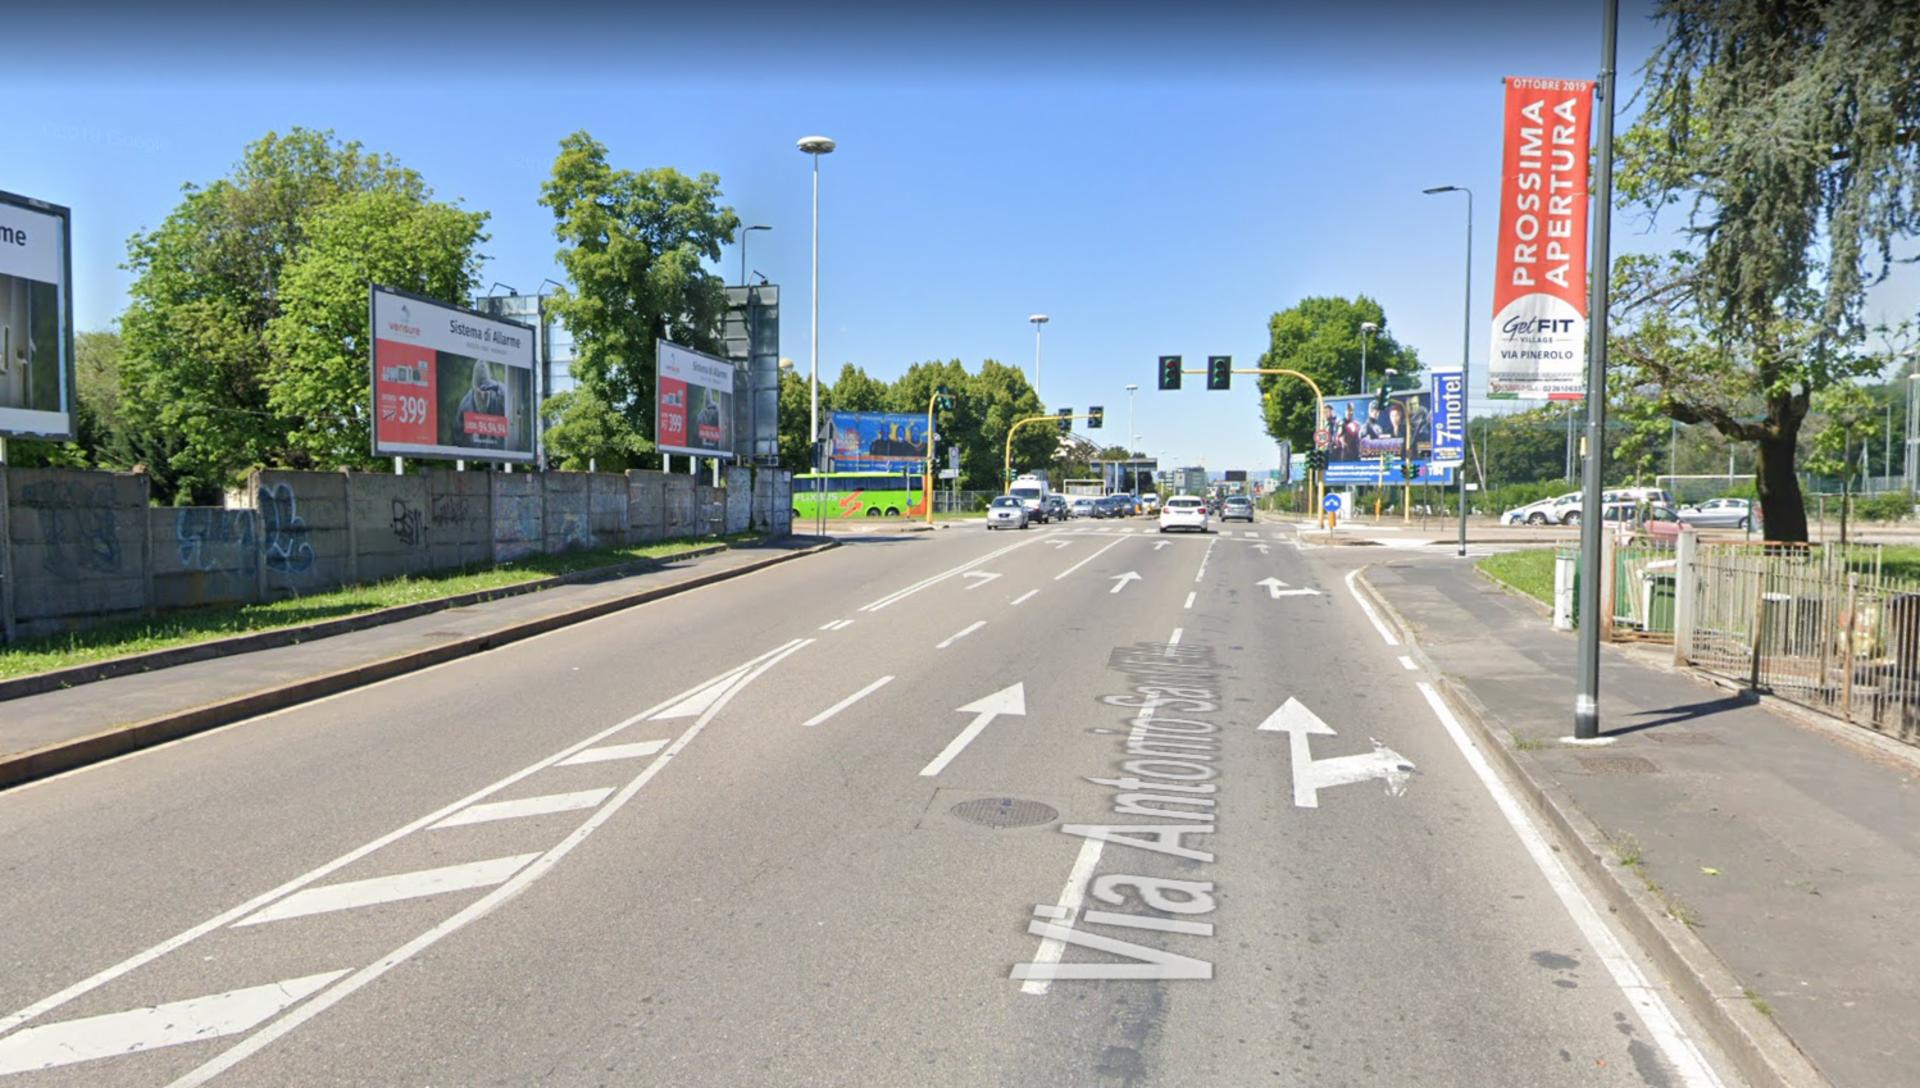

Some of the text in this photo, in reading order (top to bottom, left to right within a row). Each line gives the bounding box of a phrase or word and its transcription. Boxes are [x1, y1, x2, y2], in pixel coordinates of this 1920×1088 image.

[1513, 78, 1587, 92] OTTOBRE 2019
[1512, 99, 1545, 286] PROSSIMA
[1545, 97, 1577, 288] APERTURA
[450, 319, 482, 340] Sistema
[484, 327, 492, 342] di
[493, 331, 521, 349] Allarme
[1501, 350, 1574, 360] VIA PINEROLO
[399, 395, 426, 425] 399
